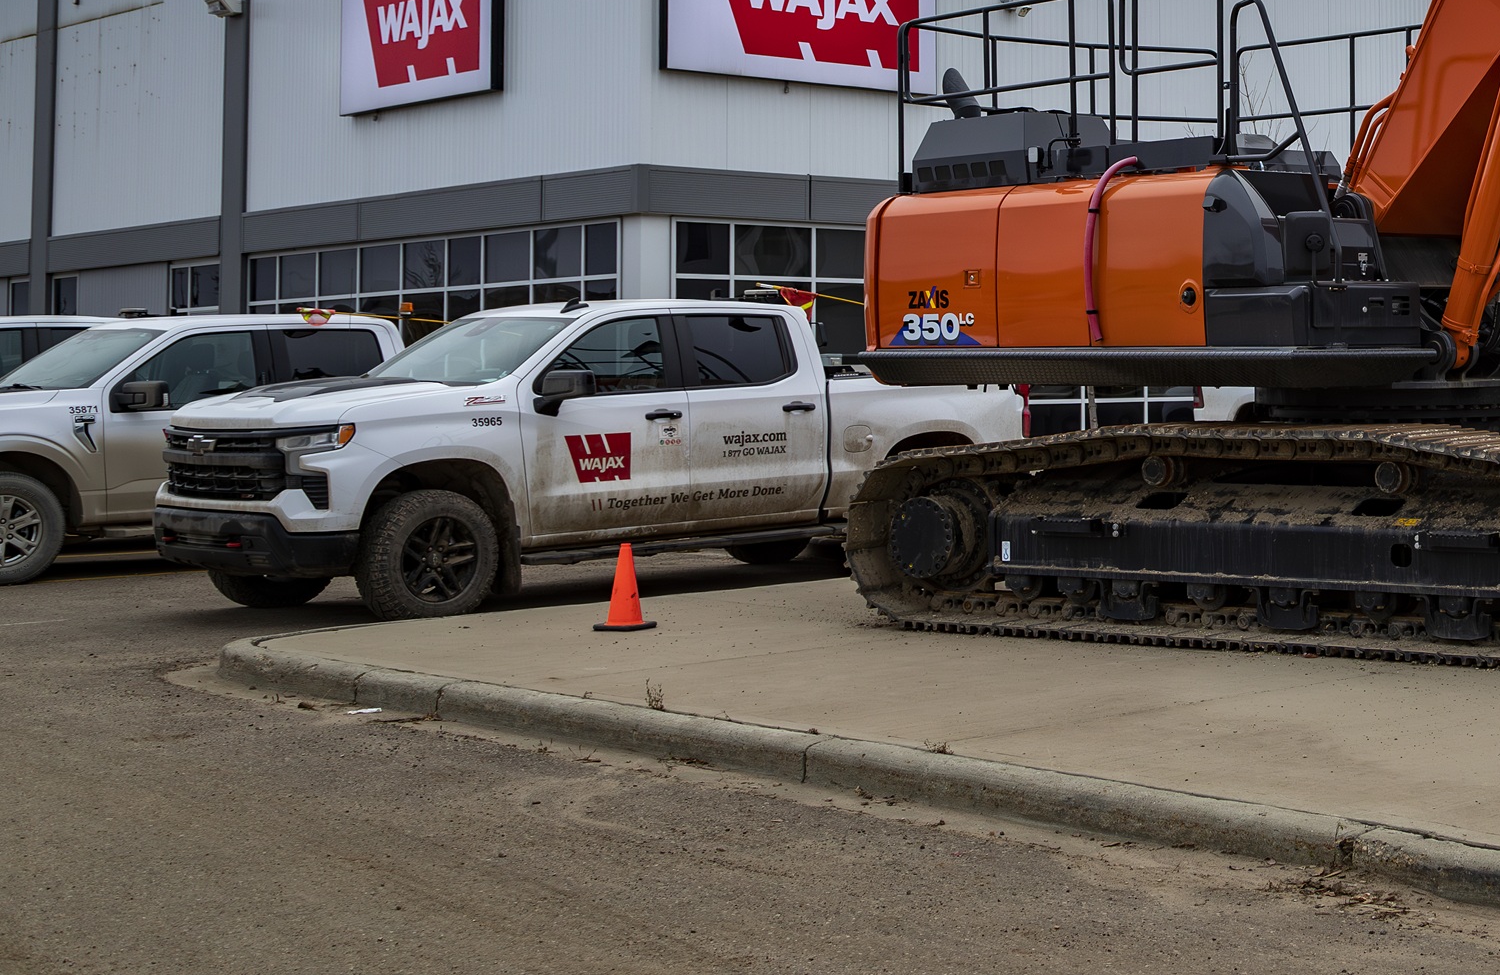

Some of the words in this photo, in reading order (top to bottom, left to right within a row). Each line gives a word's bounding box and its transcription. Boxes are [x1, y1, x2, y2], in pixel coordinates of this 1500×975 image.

[908, 285, 950, 309] ZAXIS
[69, 406, 98, 414] 35871
[471, 416, 503, 427] 35965
[722, 431, 787, 446] wajax.com
[742, 447, 755, 456] GO
[756, 445, 787, 455] WAJAX
[579, 456, 625, 473] WAJAX
[607, 494, 667, 511] Together
[671, 492, 689, 504] We
[692, 490, 714, 501] Get
[718, 488, 748, 500] More
